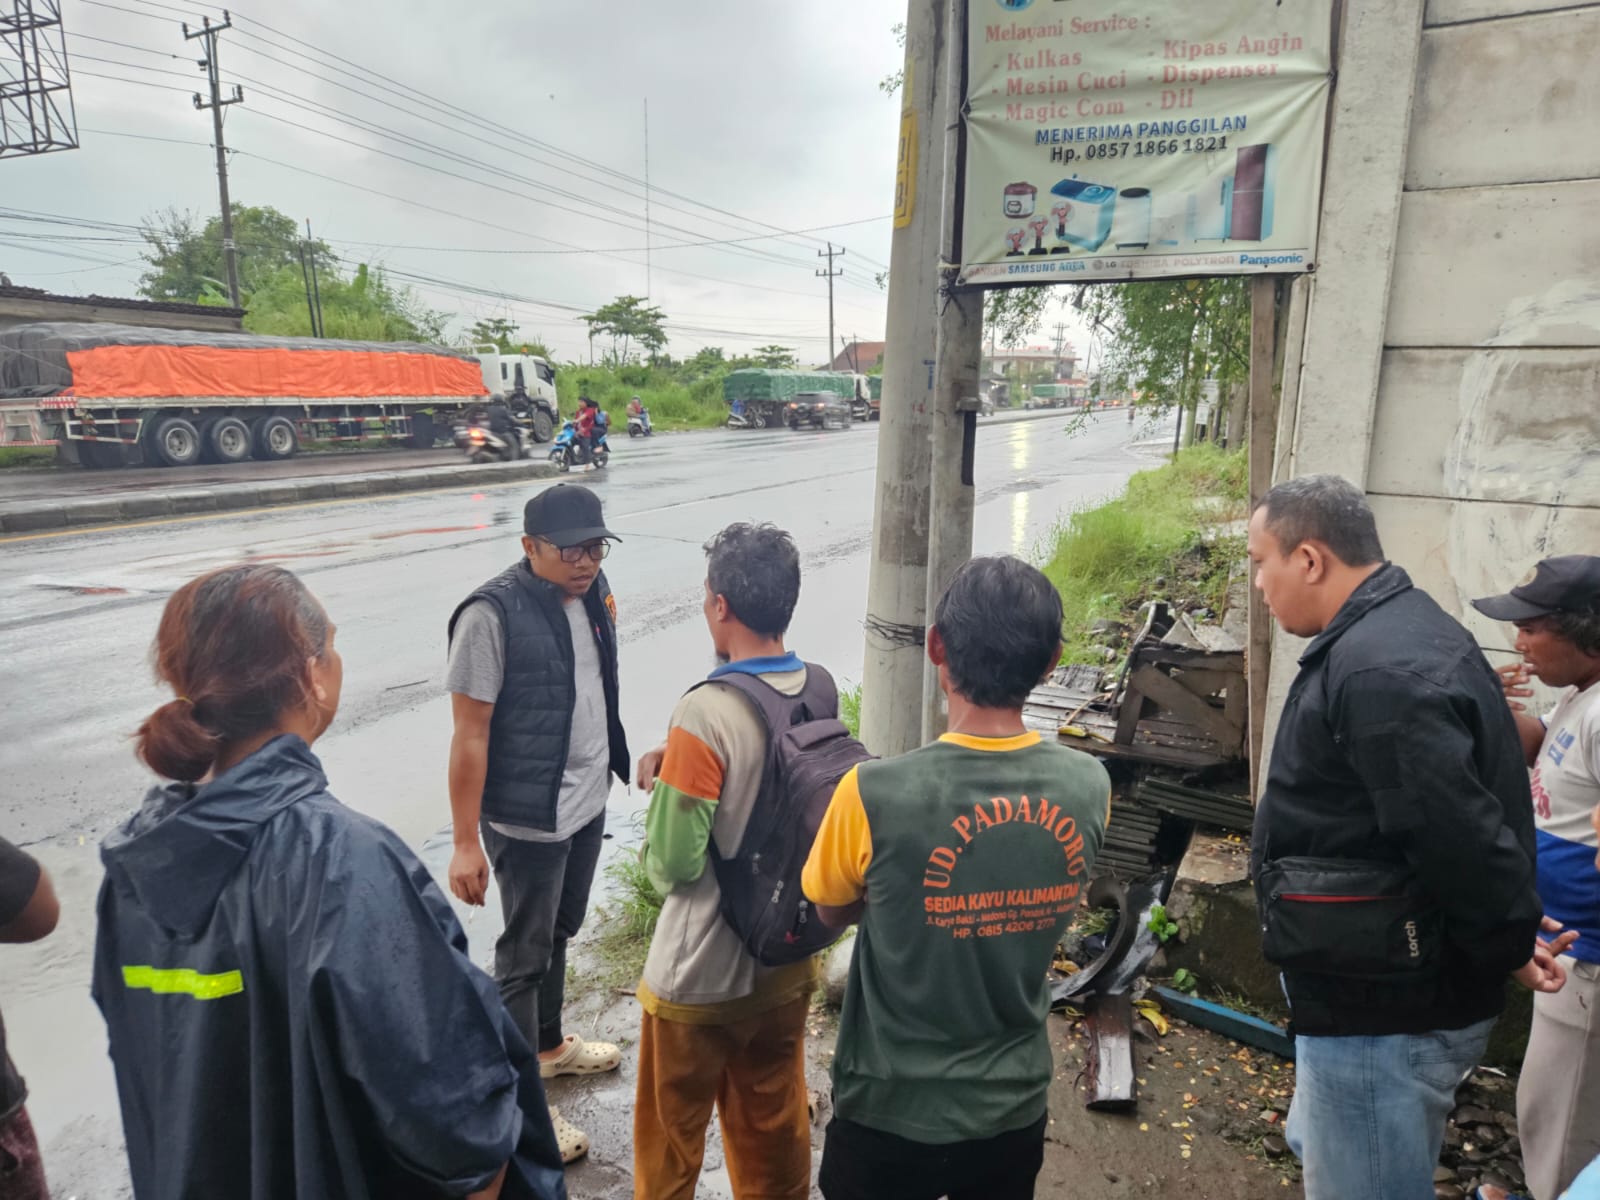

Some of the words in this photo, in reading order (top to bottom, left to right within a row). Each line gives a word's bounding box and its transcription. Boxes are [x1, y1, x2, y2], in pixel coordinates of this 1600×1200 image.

[985, 19, 1064, 43] Melayani
[1069, 13, 1138, 34] Service
[1163, 39, 1228, 61] Kipas
[1236, 32, 1304, 56] Angin
[1007, 49, 1082, 71] Kulkas
[1005, 75, 1069, 96] Mesin
[1077, 70, 1127, 92] Cuci
[1162, 62, 1279, 85] Dispenser
[1005, 101, 1069, 124] Magic
[1076, 97, 1125, 117] Com
[1035, 124, 1133, 145] MENERIMA
[1138, 115, 1248, 138] PANGGILAN
[1051, 147, 1081, 164] Hp.
[1087, 142, 1130, 160] 0857
[1134, 139, 1178, 156] 1866
[1184, 136, 1228, 152] 1821
[1008, 263, 1056, 274] SAMSUNG
[1105, 261, 1117, 269] LG
[1174, 255, 1234, 267] POLYTRON
[1240, 253, 1303, 265] Panasonic
[924, 896, 966, 913] SEDIA
[968, 890, 1004, 910] KAYU
